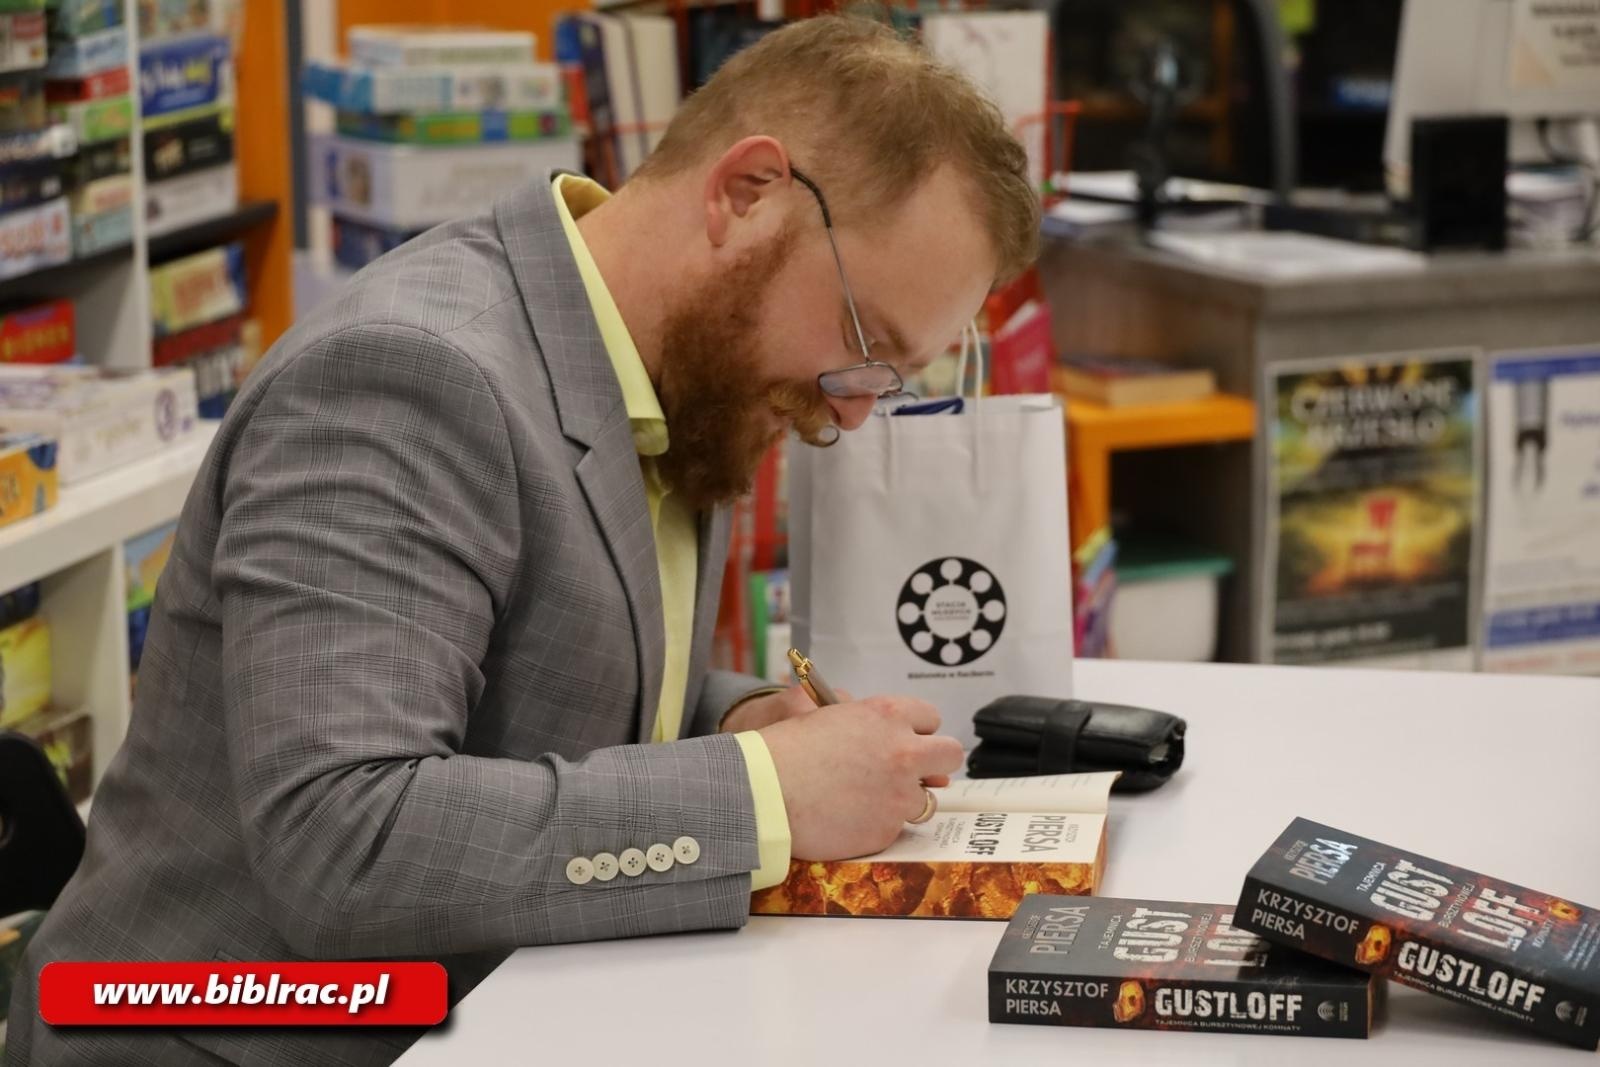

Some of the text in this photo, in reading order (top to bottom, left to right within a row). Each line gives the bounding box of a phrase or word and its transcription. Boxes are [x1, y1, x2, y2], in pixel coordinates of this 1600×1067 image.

[965, 813, 1008, 856] GUSTLOFF
[1021, 815, 1067, 853] PIERSA
[1289, 837, 1359, 886] PIERSA
[1256, 887, 1360, 935] KRZYSZTOF
[1370, 858, 1454, 921] GUST
[1029, 906, 1091, 955] PIERSA
[1113, 906, 1193, 963] GUST
[1251, 908, 1306, 940] PIERSA
[1457, 887, 1541, 953] LOFF
[1005, 978, 1109, 1000] KRZYSZTOF
[1397, 940, 1547, 1013] GUSTLOFF
[1005, 999, 1063, 1017] PIERSA
[1154, 1018, 1199, 1028] TAJEMNICA
[1155, 987, 1303, 1022] GUSTLOFF
